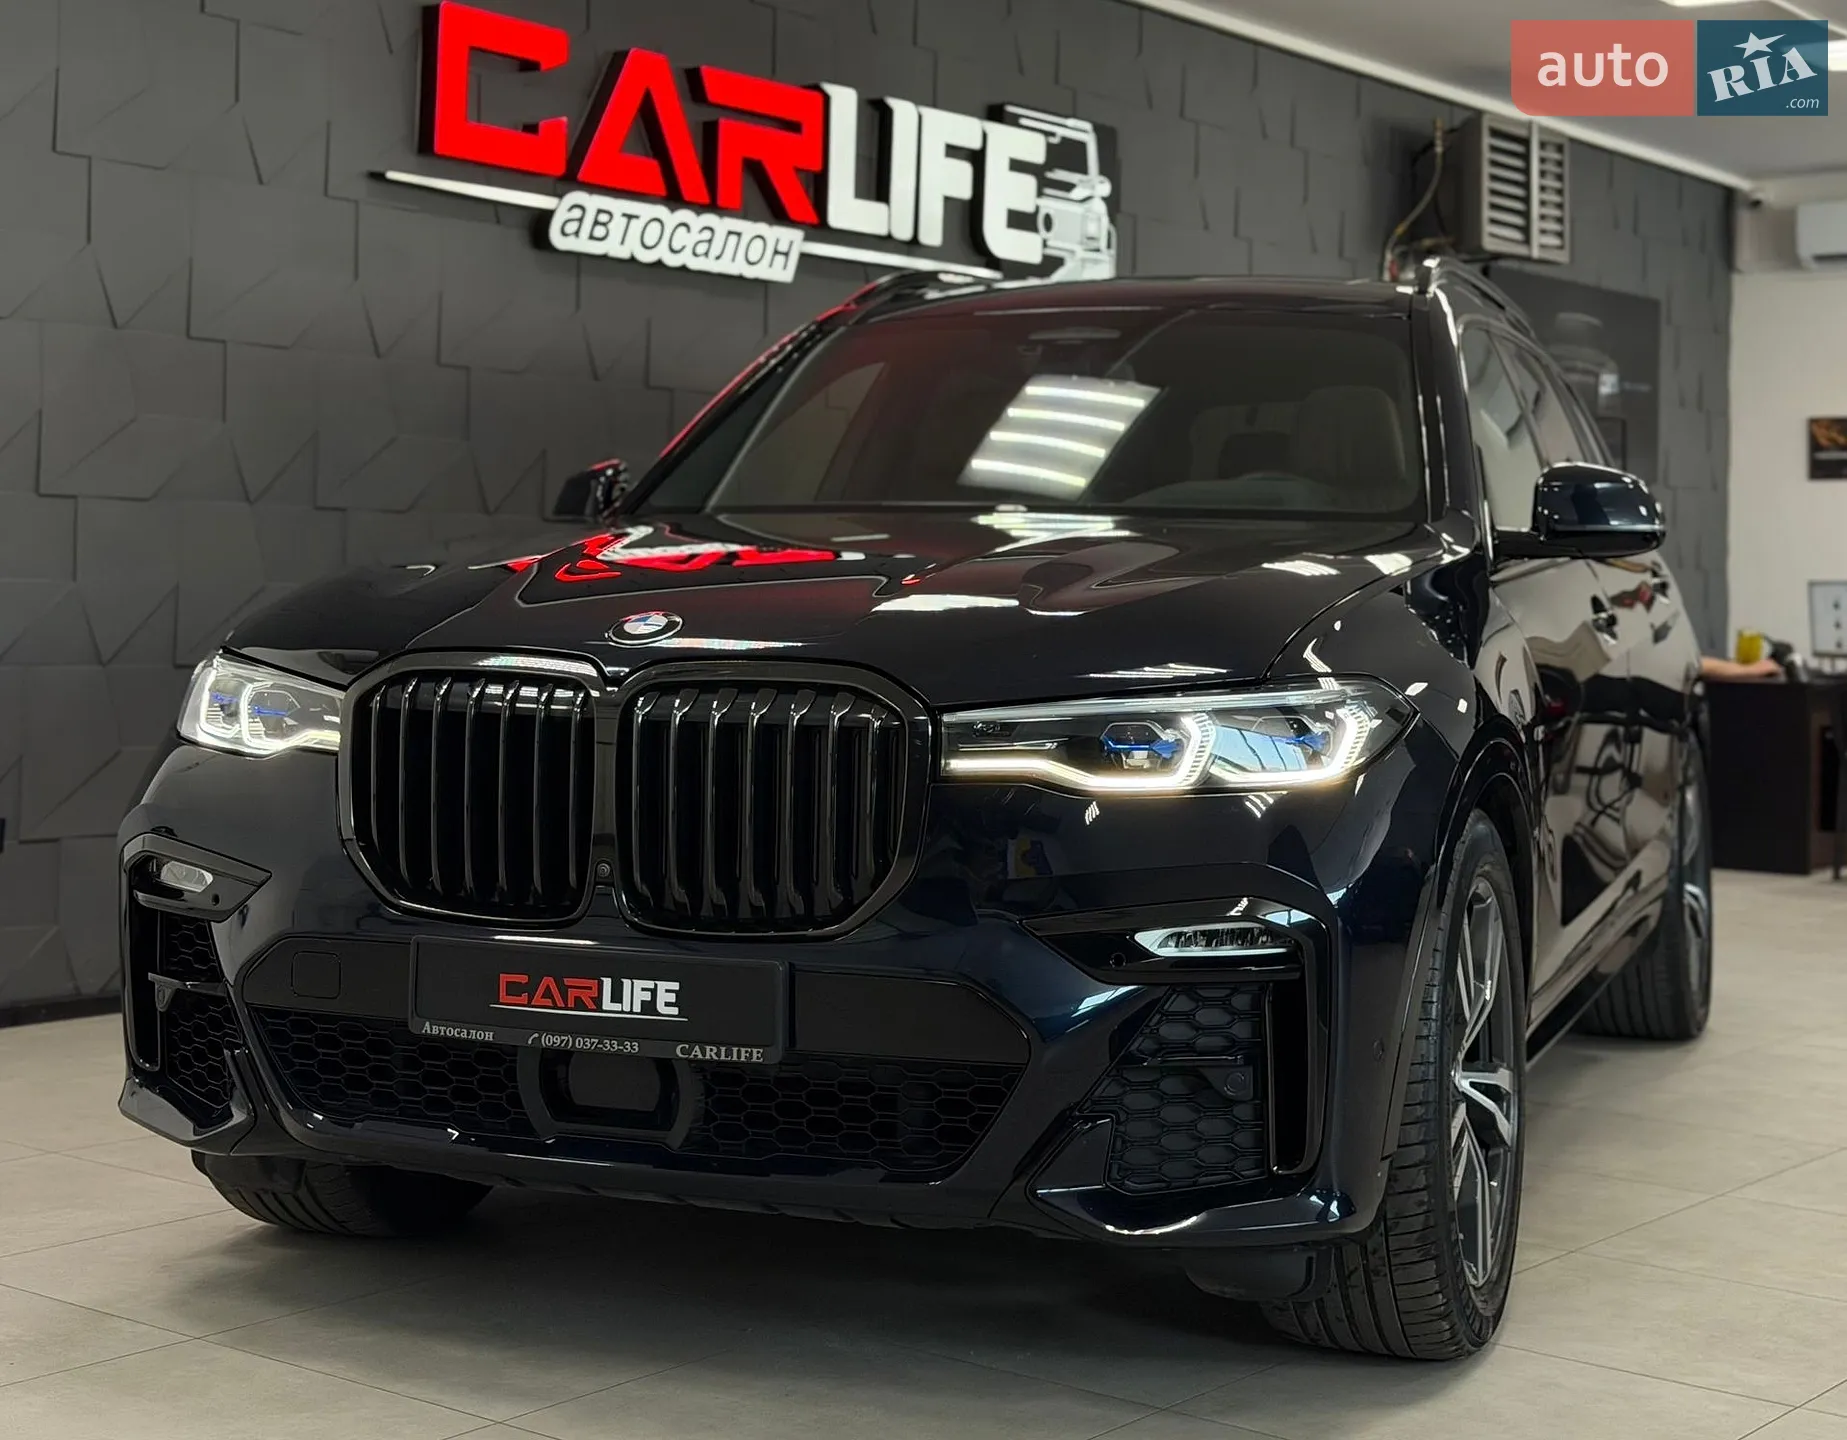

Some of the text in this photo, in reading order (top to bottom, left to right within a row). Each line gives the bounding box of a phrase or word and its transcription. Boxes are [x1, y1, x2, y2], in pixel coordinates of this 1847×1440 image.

[426, 1, 1047, 265] CARLIFE
[558, 202, 795, 276] автосалон
[498, 973, 680, 1015] CARLIFE
[421, 1020, 495, 1042] Автосалон
[540, 1032, 640, 1053] (097) 037-33-33
[675, 1043, 764, 1063] CARLIFE
